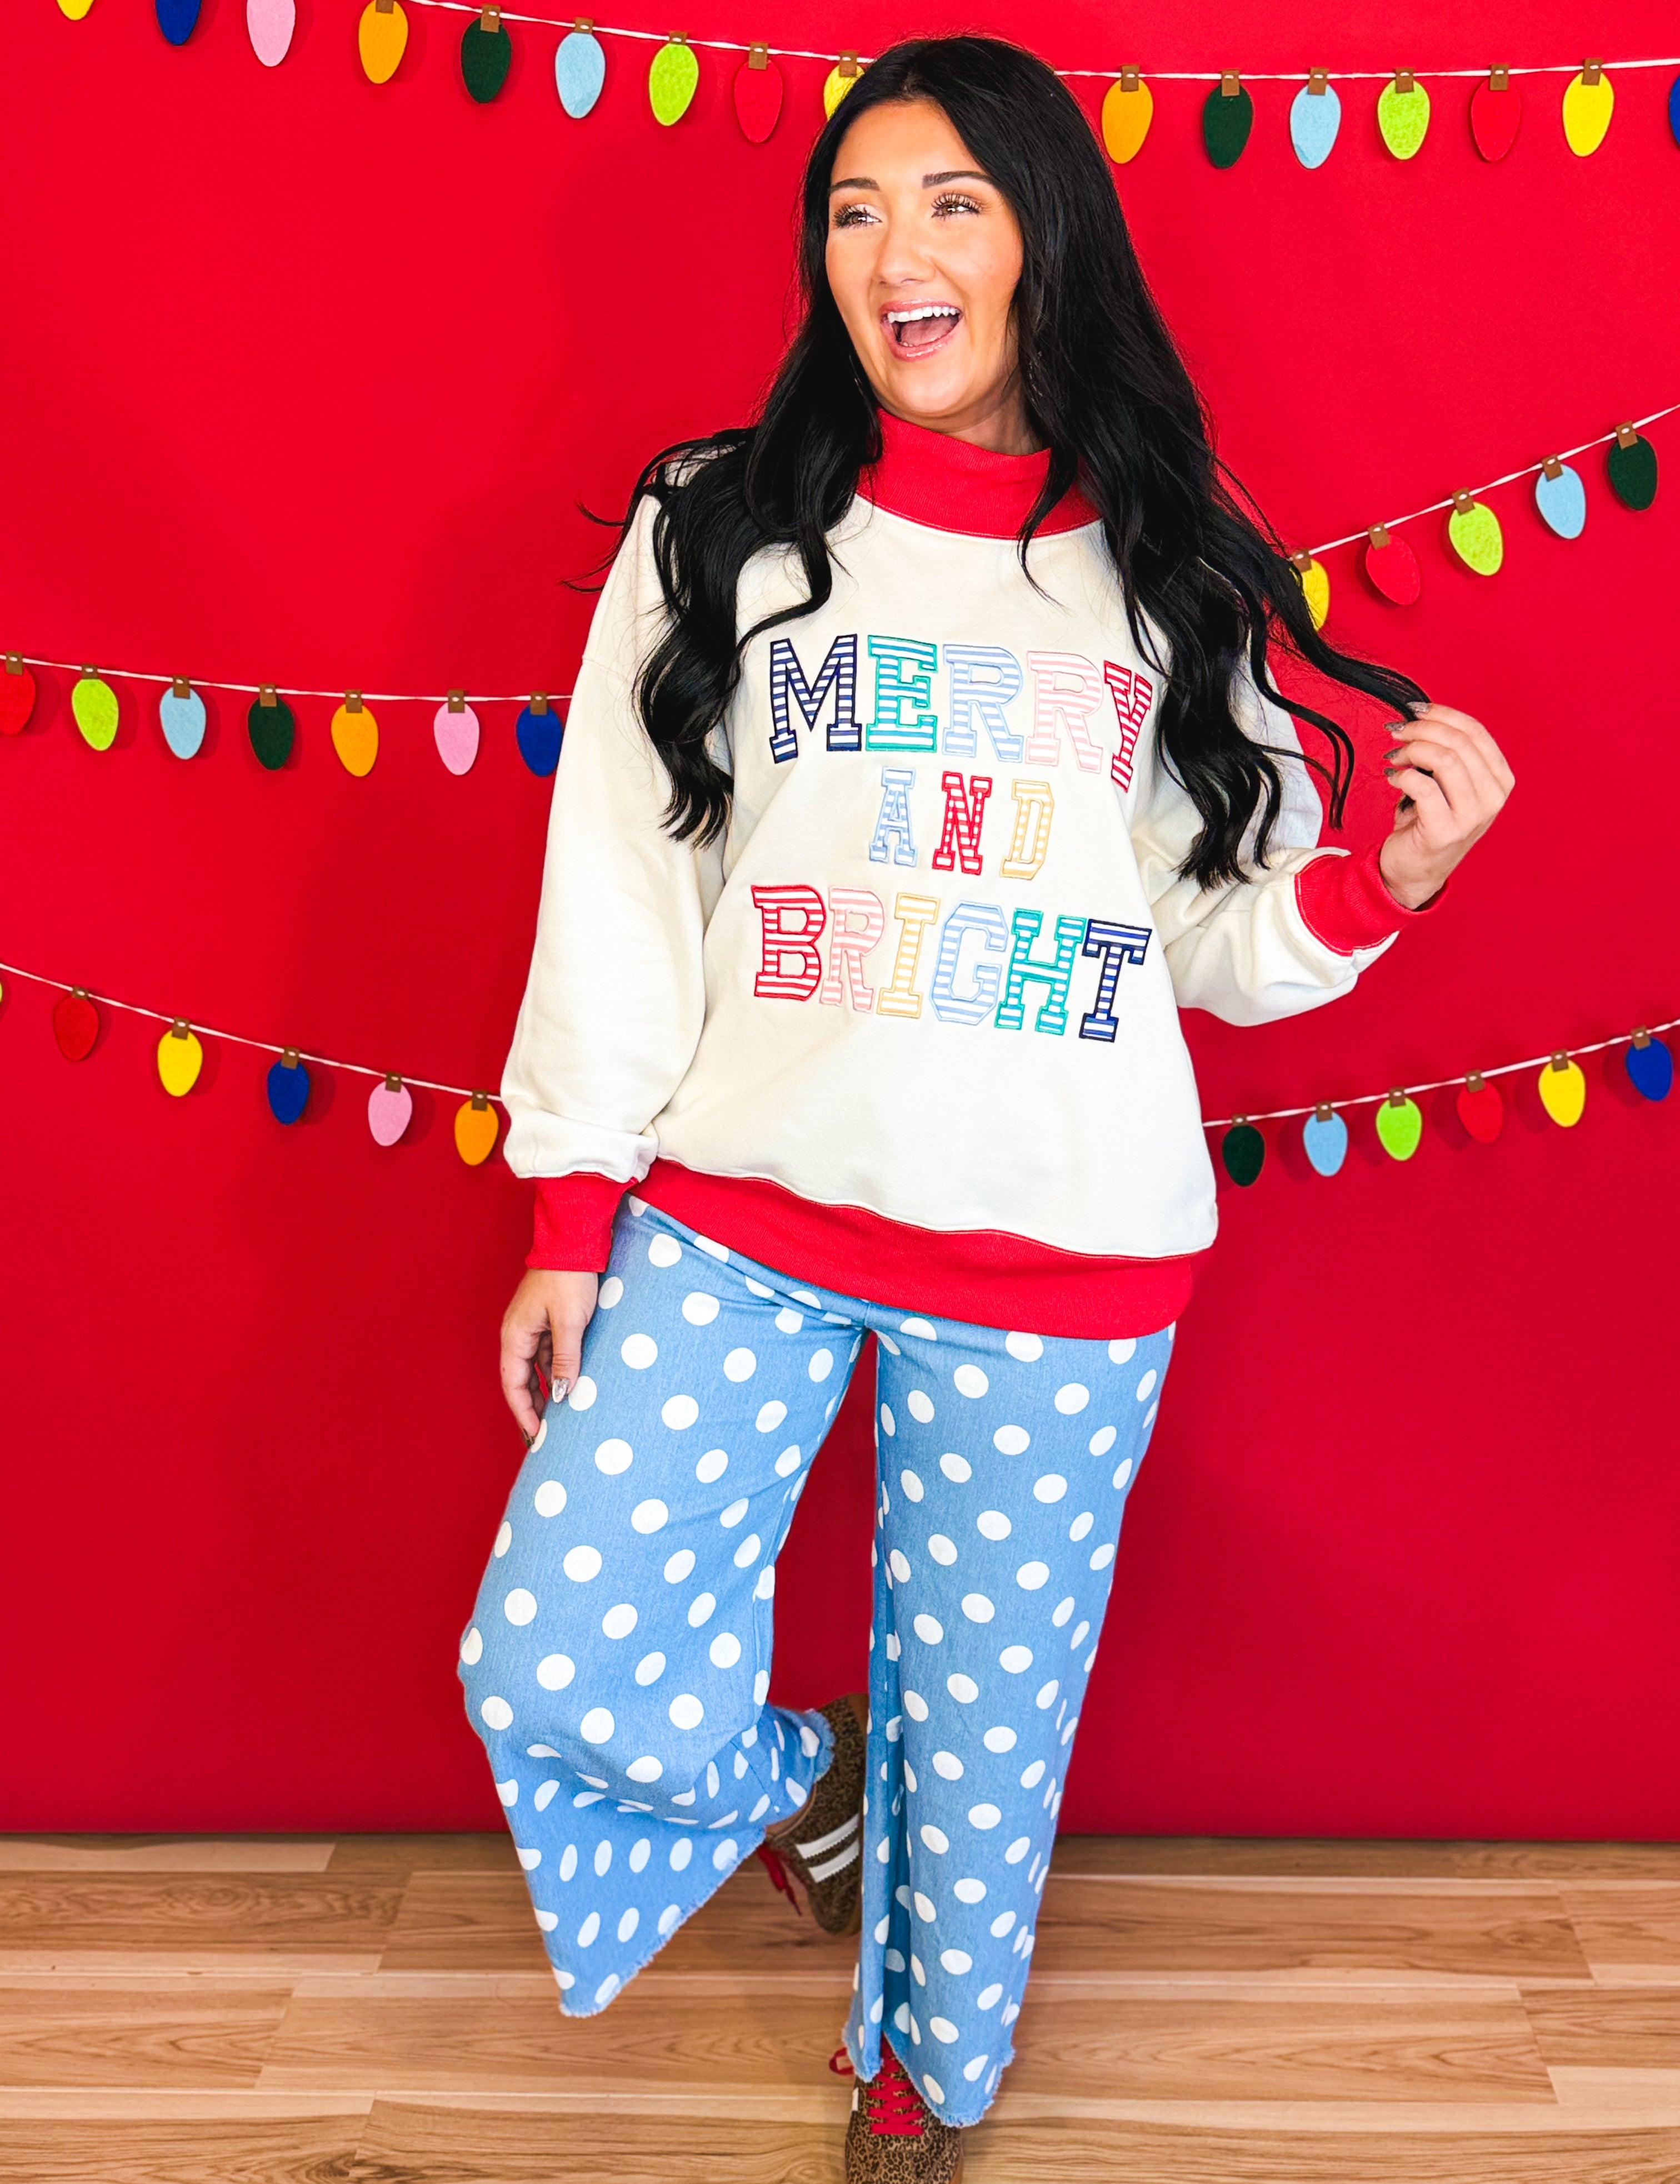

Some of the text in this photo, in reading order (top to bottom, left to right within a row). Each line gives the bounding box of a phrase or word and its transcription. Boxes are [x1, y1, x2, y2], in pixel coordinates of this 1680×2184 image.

[769, 634, 1153, 793] MERRY
[869, 767, 1054, 880] AND
[751, 884, 1152, 1043] BRIGHT
